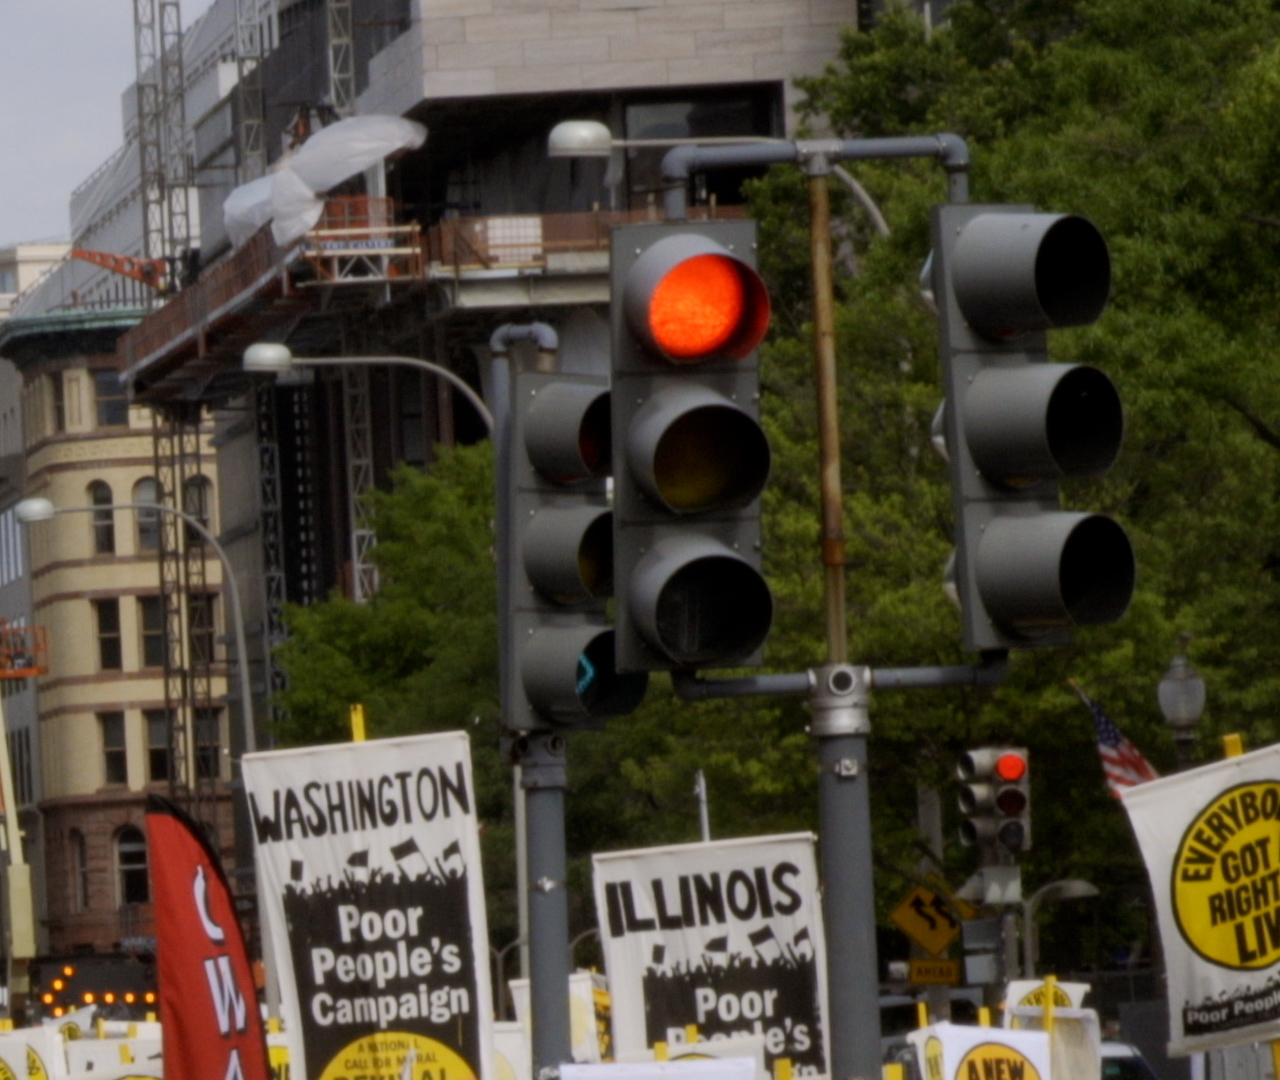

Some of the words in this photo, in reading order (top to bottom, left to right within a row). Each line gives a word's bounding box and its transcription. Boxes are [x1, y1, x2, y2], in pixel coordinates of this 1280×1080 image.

[249, 761, 469, 844] WASHINGTON
[1221, 836, 1271, 884] GOT
[605, 862, 802, 938] ILLINOIS
[339, 904, 423, 943] Poor
[311, 937, 461, 989] People's
[312, 984, 469, 1029] Campaign
[695, 987, 778, 1022] Poor
[1187, 1007, 1228, 1025] Poor
